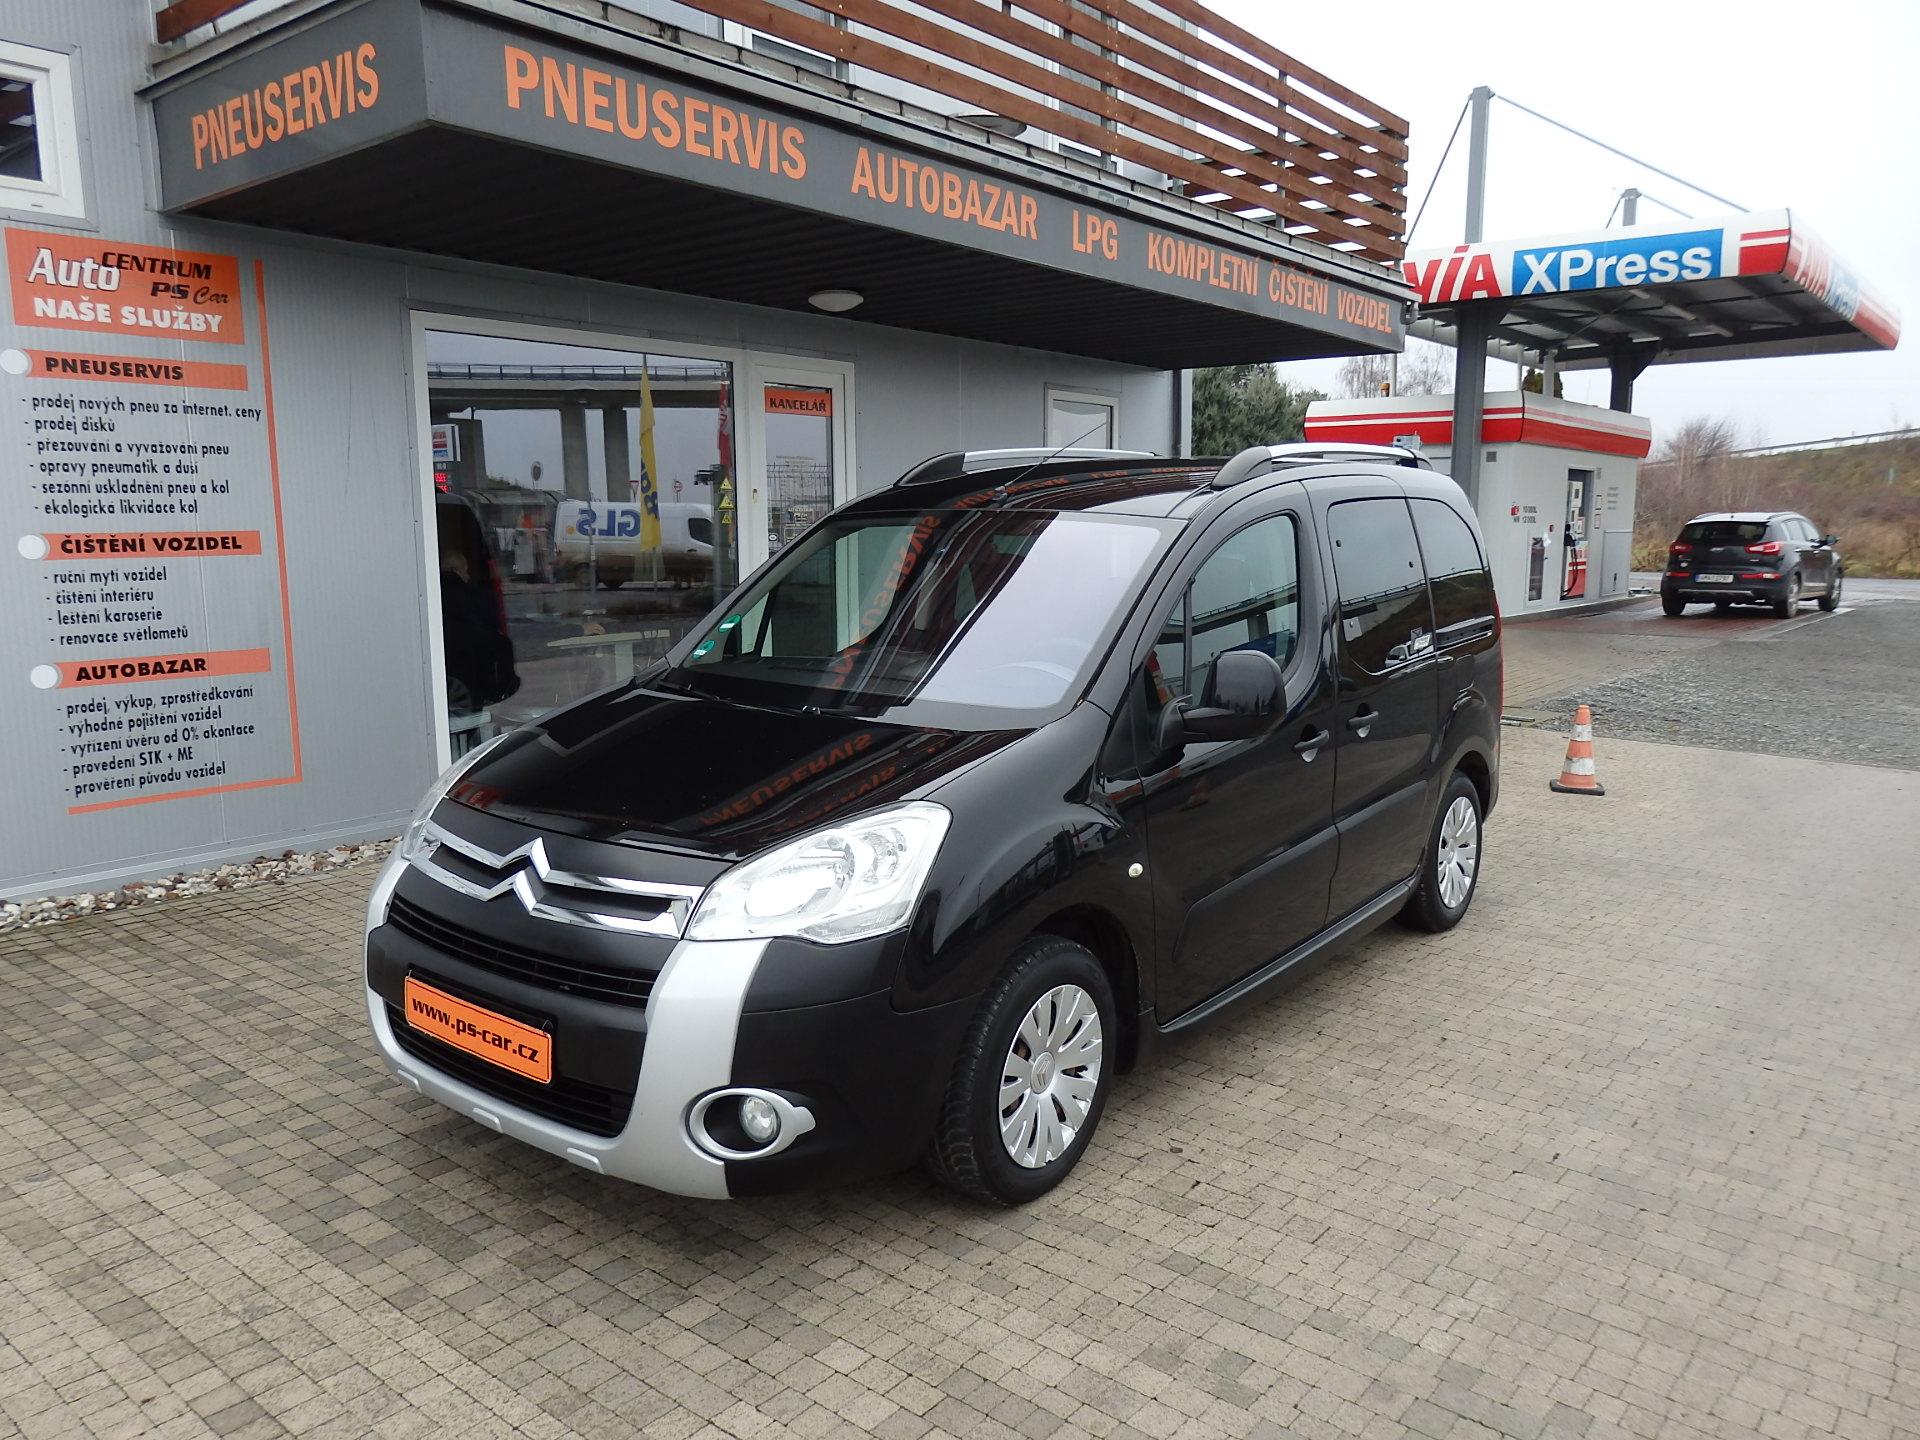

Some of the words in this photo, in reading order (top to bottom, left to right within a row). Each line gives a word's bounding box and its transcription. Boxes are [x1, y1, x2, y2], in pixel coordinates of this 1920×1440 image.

[191, 42, 379, 171] PNEUSERVIS
[504, 44, 807, 180] PNEUSERVIS
[851, 146, 1038, 240] AUTOBAZAR
[1072, 209, 1119, 261] LPG
[1147, 231, 1260, 296] KOMPLETNÍ
[1268, 258, 1329, 315] ČIŠTĚNÍ
[1337, 288, 1393, 333] VOZIDEL
[26, 247, 121, 291] Auto
[101, 251, 212, 279] CENTRUM
[1521, 246, 1713, 294] XPress
[150, 281, 190, 299] PS
[193, 286, 230, 304] Car
[34, 295, 112, 323] NAŠE
[121, 304, 223, 333] SLUŽBY
[45, 357, 183, 380] PNEUSERVIS
[32, 393, 75, 413] prodej
[79, 396, 125, 414] nových
[129, 402, 159, 415] pneu
[164, 403, 178, 414] za
[182, 400, 232, 417] internet.
[235, 407, 262, 422] ceny
[769, 397, 827, 412] KANCELÁŘ
[34, 415, 77, 435] prodej
[81, 416, 115, 432] disků
[37, 438, 110, 455] přezouvání
[114, 443, 122, 452] a
[127, 441, 198, 458] vyvažování
[201, 445, 229, 458] pneu
[40, 462, 86, 477] opravy
[91, 459, 159, 477] pneumatik
[163, 464, 170, 473] a
[42, 480, 91, 494] sezónní
[95, 479, 164, 494] uskladnění
[167, 484, 196, 497] pneu
[200, 484, 207, 494] a
[211, 479, 230, 494] kol
[44, 499, 116, 519] ekologická
[120, 499, 176, 514] likvidace
[179, 499, 198, 514] kol
[60, 533, 146, 554] ČIŠTĚNÍ
[152, 536, 242, 552] VOZIDEL
[53, 570, 86, 584] ruční
[90, 568, 119, 586] mytí
[123, 566, 167, 581] vozidel
[56, 588, 97, 604] čištění
[101, 587, 154, 603] interiéru
[57, 609, 100, 625] leštění
[104, 606, 163, 622] karoserie
[60, 632, 118, 646] renovace
[123, 625, 188, 641] světlometů
[75, 658, 207, 681] AUTOBAZAR
[67, 697, 110, 718] prodej,
[115, 694, 156, 713] výkup,
[161, 685, 254, 708] zprostředkování
[68, 717, 123, 738] výhodné
[128, 711, 177, 732] pojištění
[181, 704, 222, 722] vozidel
[70, 737, 122, 757] vyřízení
[126, 733, 160, 749] úvěru
[164, 728, 178, 744] od
[182, 726, 200, 742] 0%
[203, 724, 255, 739] akontace
[73, 755, 135, 779] provedení
[140, 749, 162, 766] STK
[177, 746, 193, 761] ME
[75, 774, 135, 798] prověření
[139, 767, 181, 789] původu
[185, 760, 226, 779] vozidel
[412, 998, 540, 1063] www.ps-car.cz
